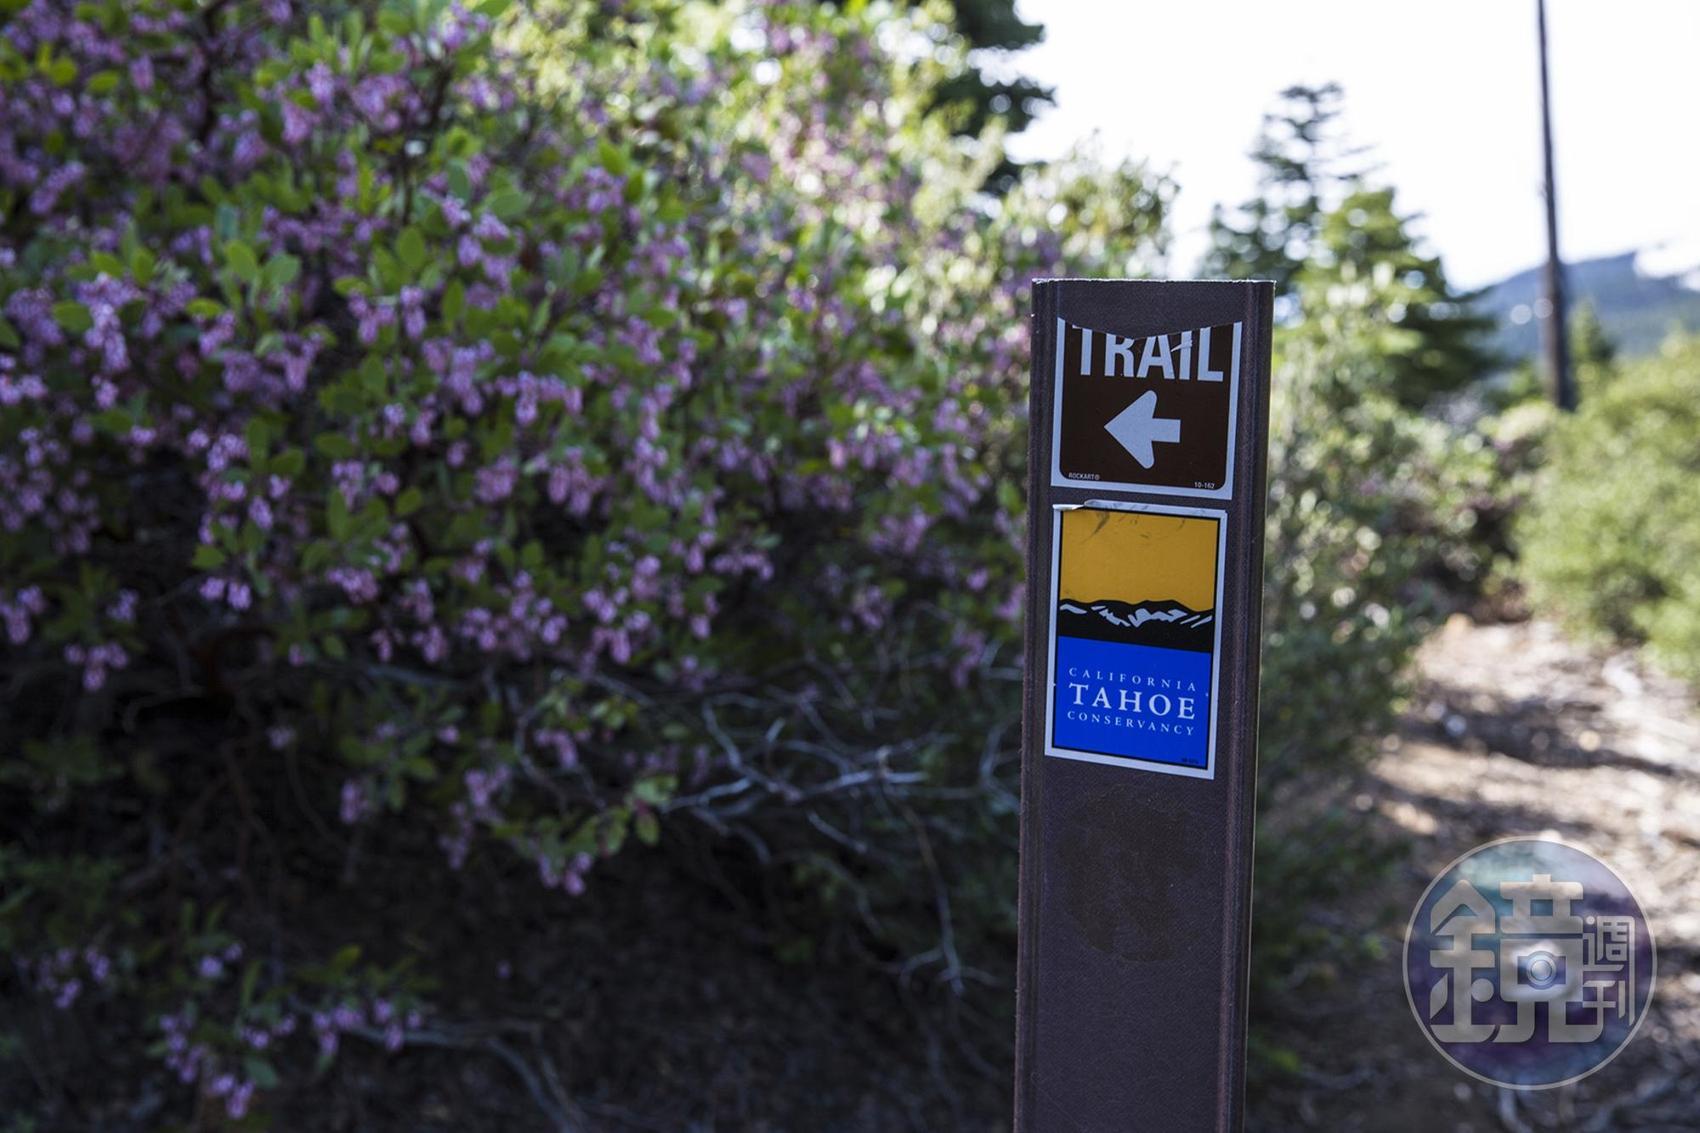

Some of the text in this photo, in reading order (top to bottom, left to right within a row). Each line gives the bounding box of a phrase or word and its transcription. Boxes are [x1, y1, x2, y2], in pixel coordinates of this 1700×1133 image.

[1072, 325, 1223, 382] TRAIL
[1068, 667, 1196, 692] CALIFORNIA
[1068, 682, 1195, 720] TAHOE
[1067, 710, 1194, 736] CONSERVANCY
